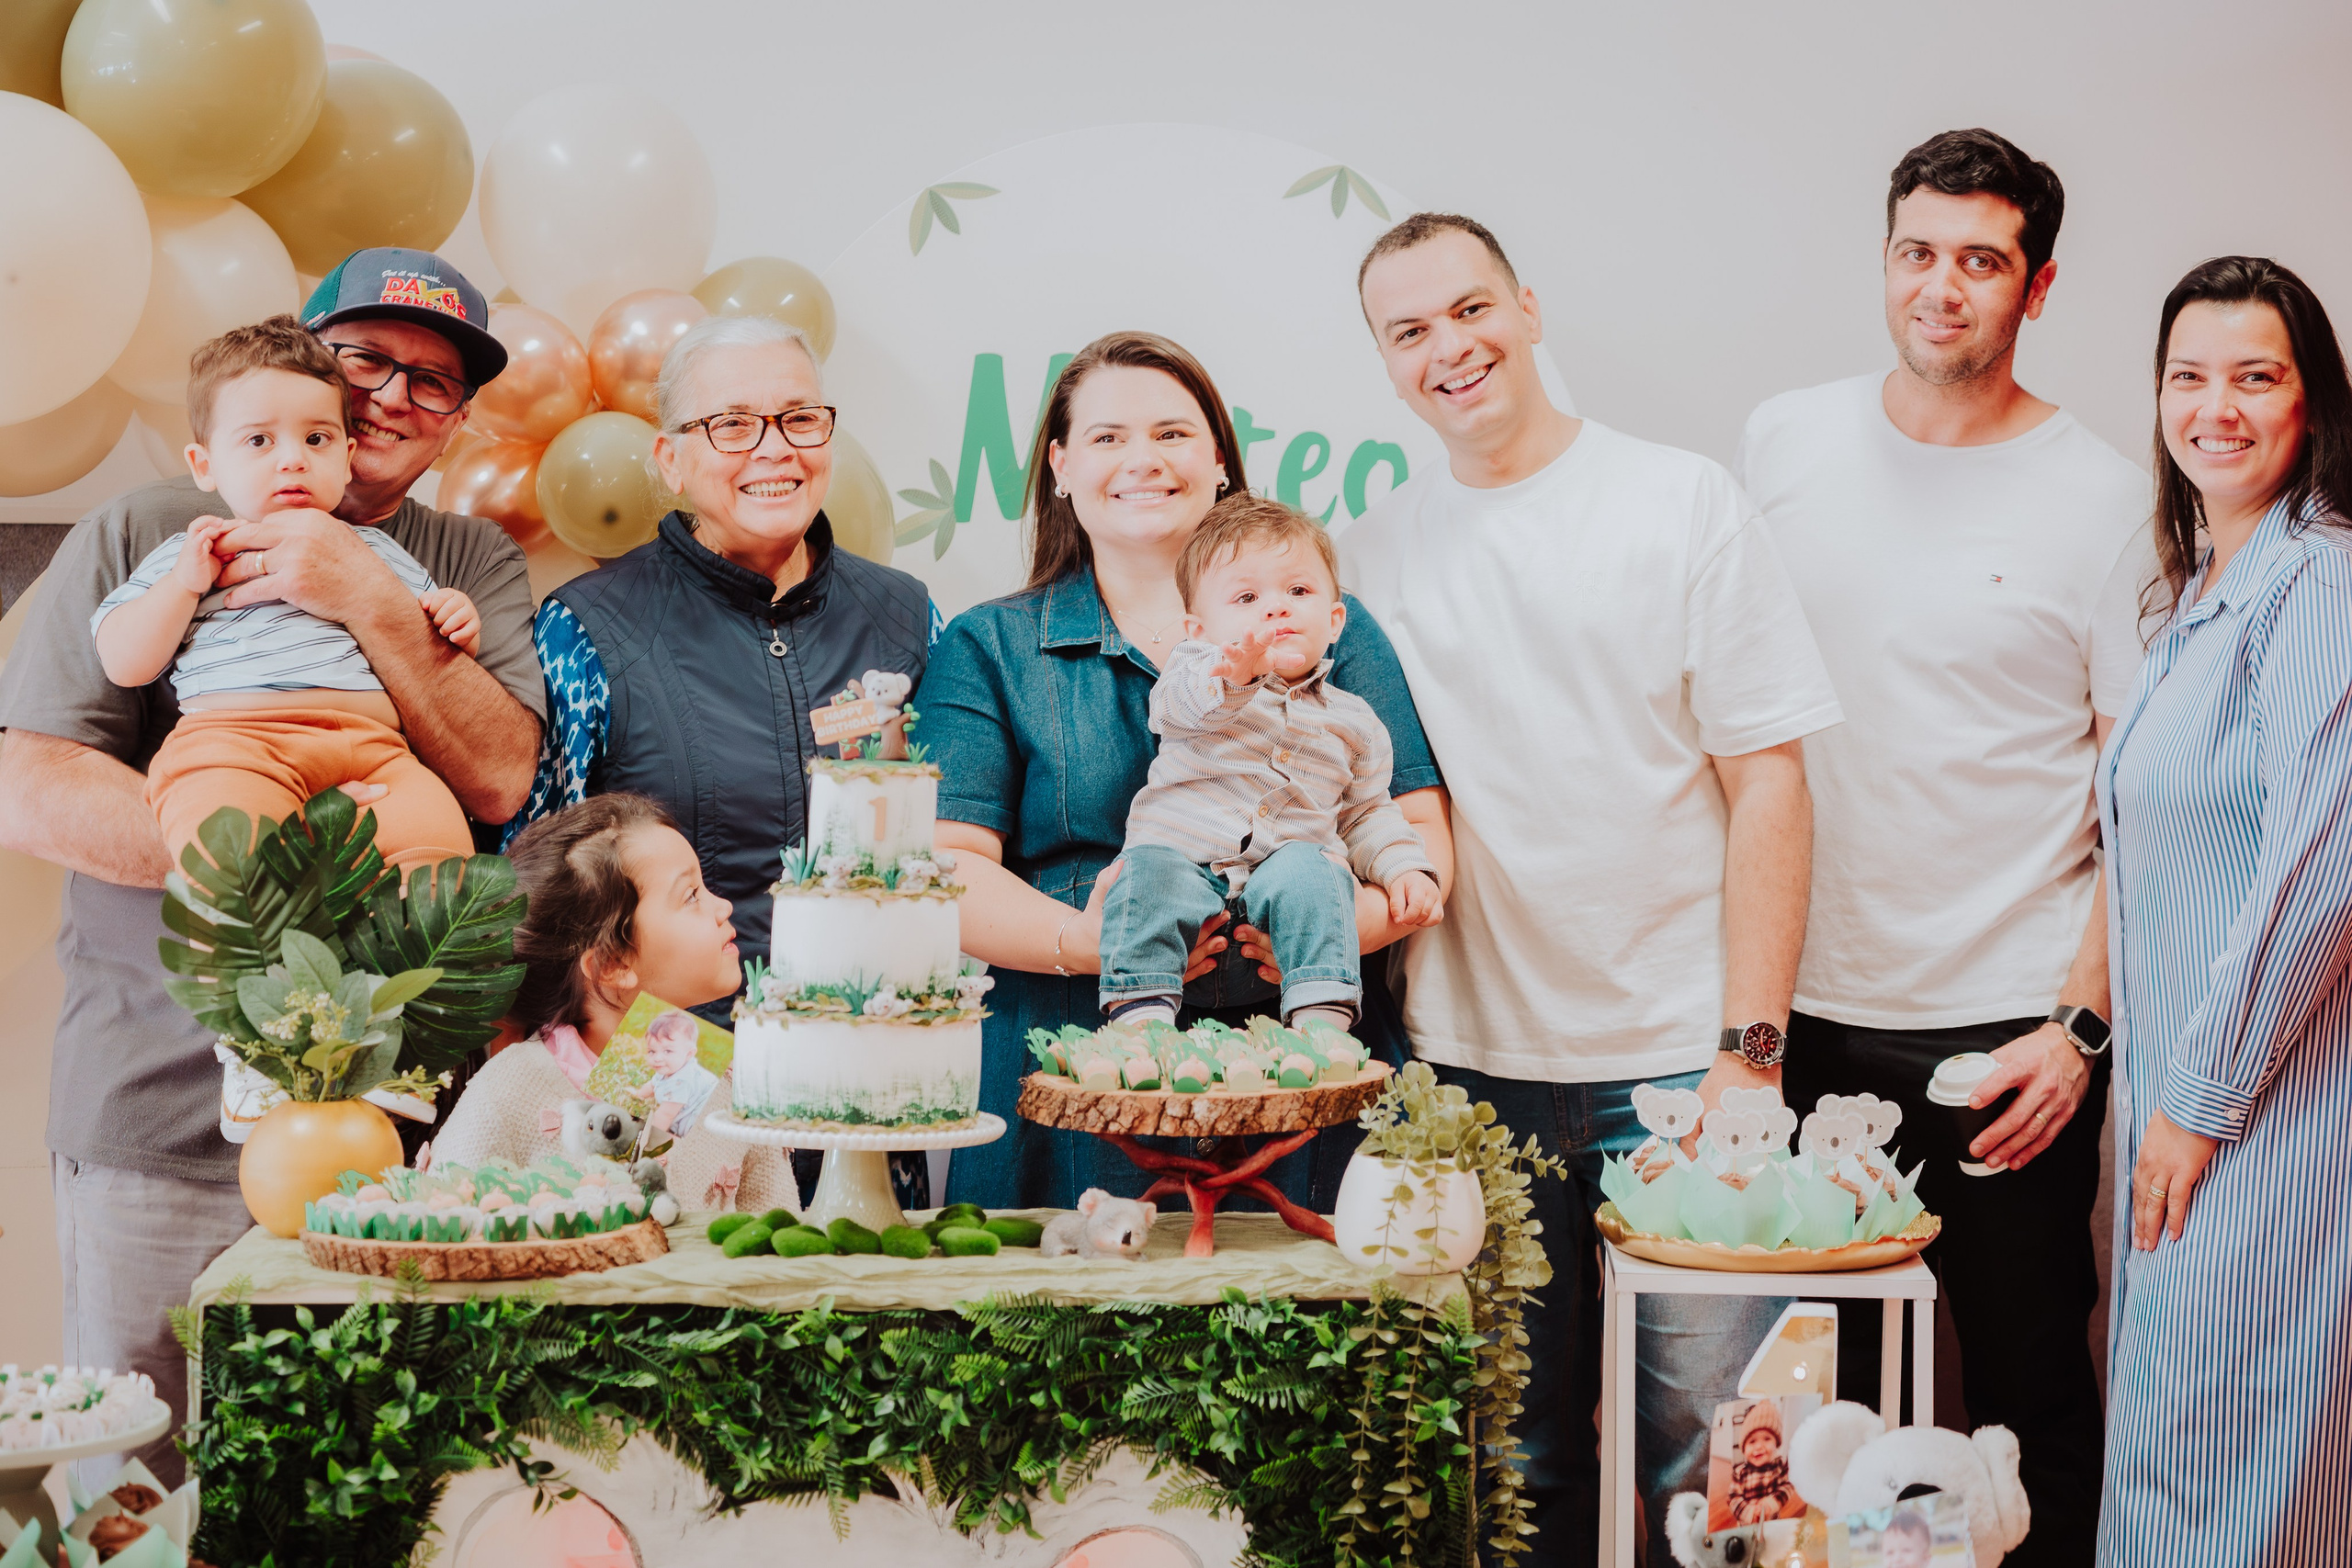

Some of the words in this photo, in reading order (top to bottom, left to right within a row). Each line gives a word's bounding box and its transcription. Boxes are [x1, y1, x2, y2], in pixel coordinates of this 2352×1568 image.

[954, 352, 1410, 526] Mteo
[823, 704, 864, 724] HAPPY
[868, 796, 888, 840] 1
